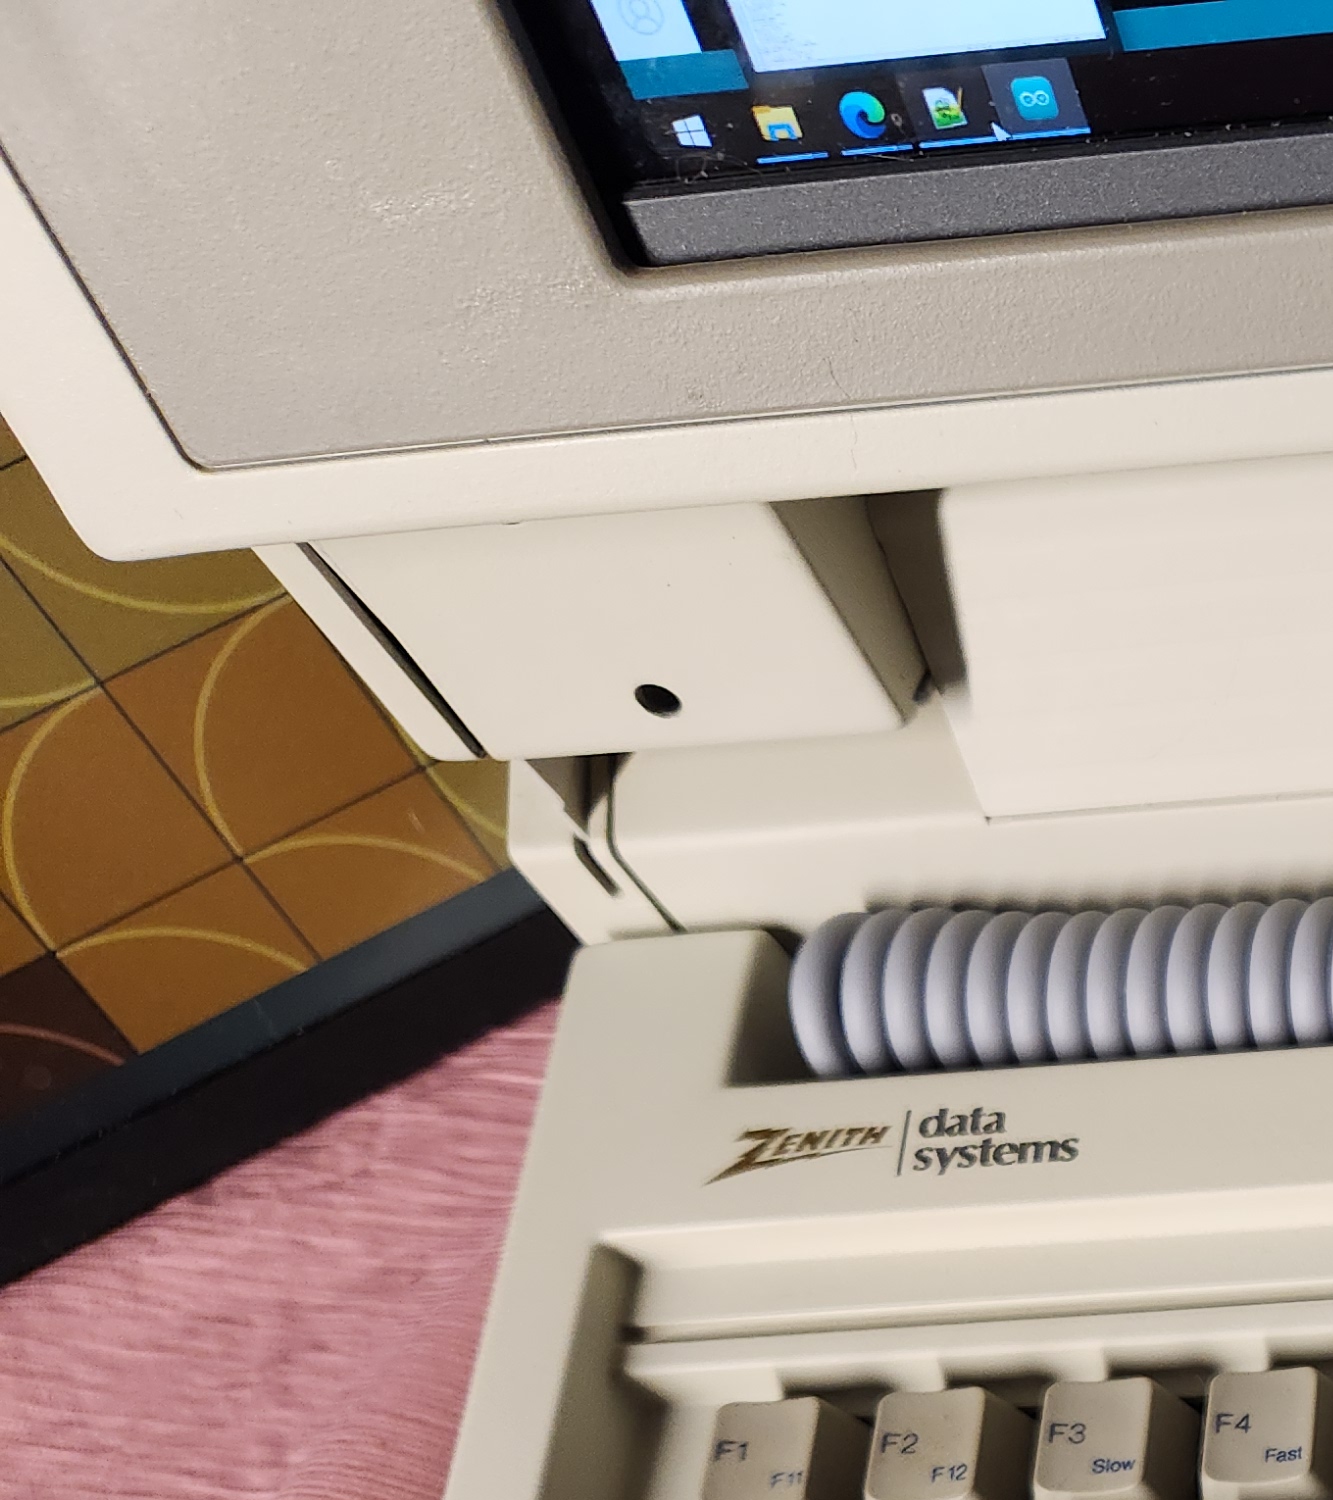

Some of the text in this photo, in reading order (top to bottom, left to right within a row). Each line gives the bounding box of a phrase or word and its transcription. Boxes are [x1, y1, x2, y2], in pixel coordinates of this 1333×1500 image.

[919, 1107, 1007, 1138] data
[702, 1126, 893, 1186] ZENITH
[913, 1135, 1080, 1176] systems
[1048, 1423, 1085, 1444] F3
[1214, 1413, 1251, 1434] F4
[715, 1440, 747, 1462] F1
[881, 1433, 919, 1454] F2
[1264, 1445, 1302, 1463] Fast
[932, 1462, 968, 1482] F12
[1092, 1455, 1136, 1476] Slow
[771, 1470, 804, 1488] F11
